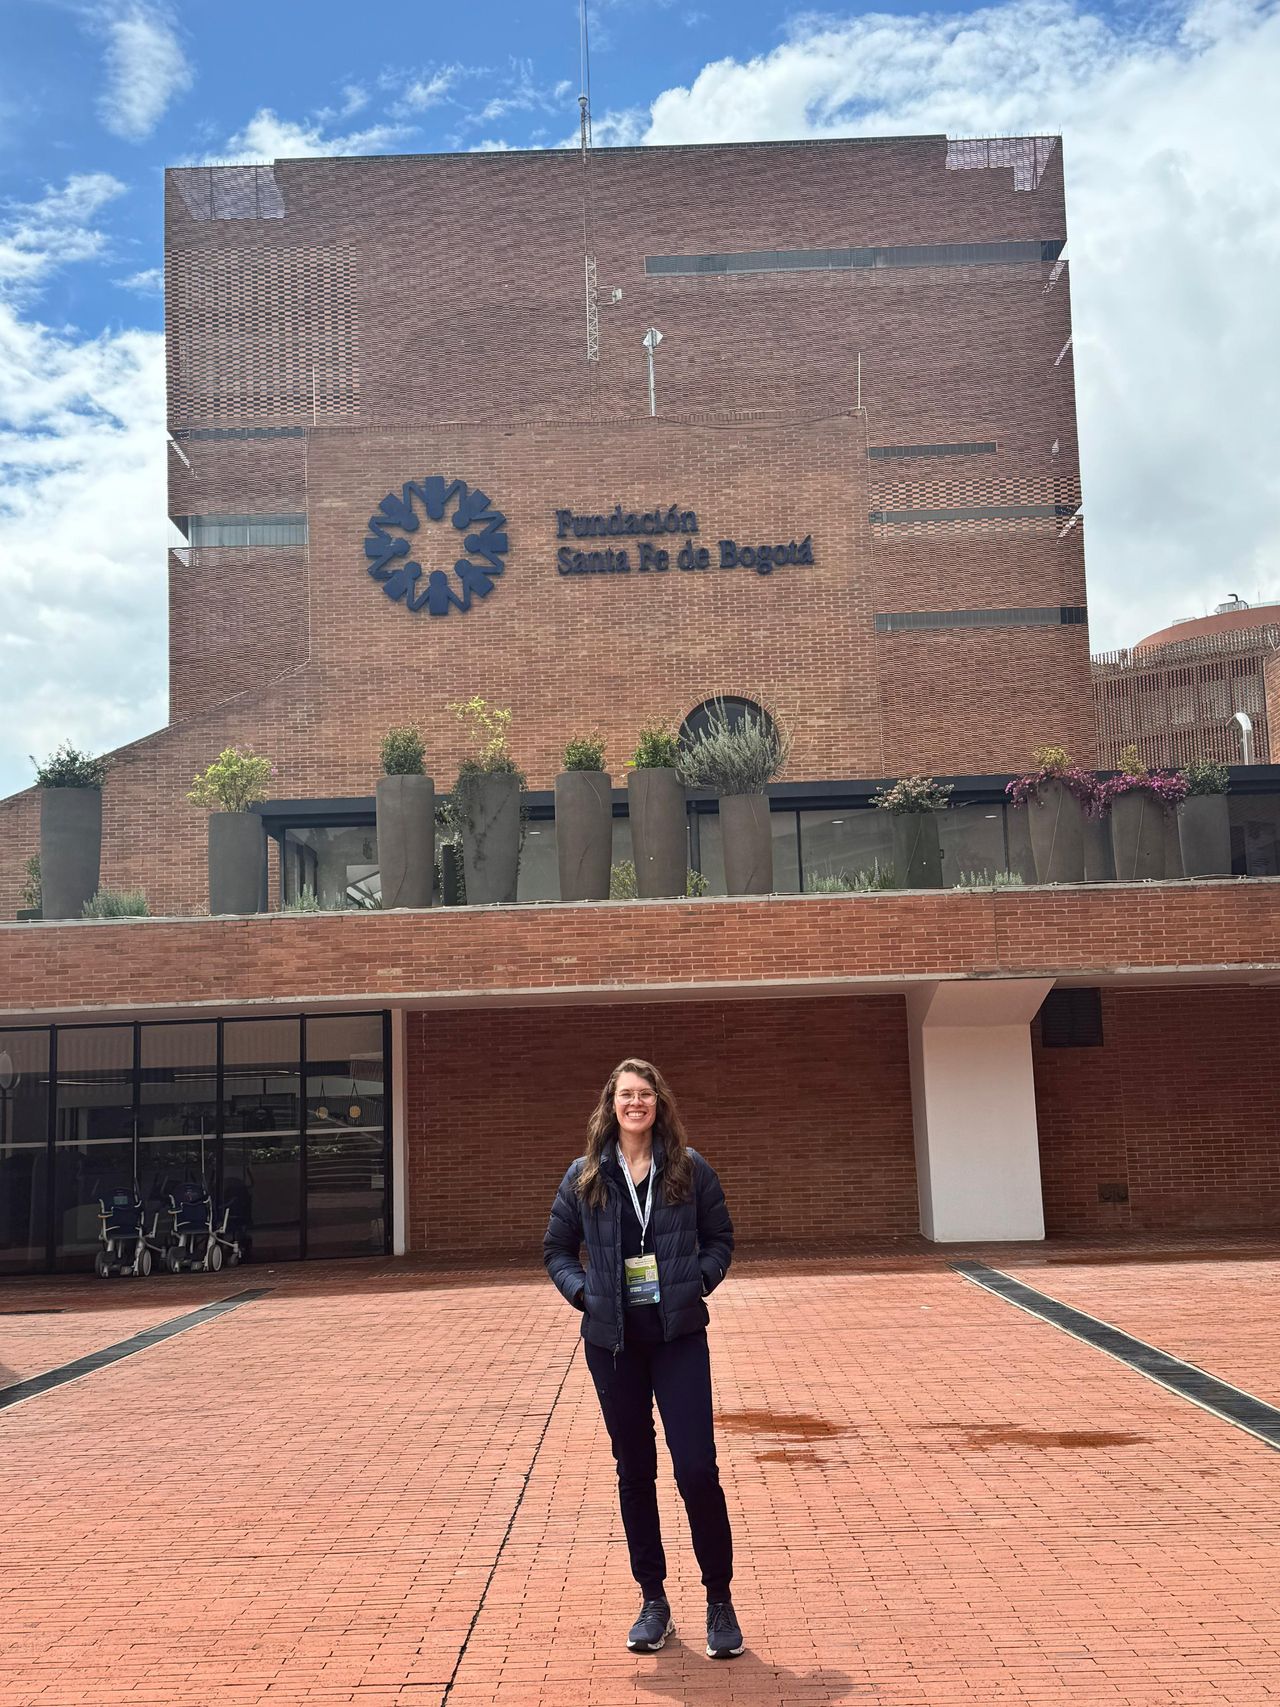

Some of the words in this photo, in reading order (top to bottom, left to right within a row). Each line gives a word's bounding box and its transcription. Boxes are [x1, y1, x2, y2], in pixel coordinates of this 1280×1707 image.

[556, 504, 698, 538] Fundación
[557, 546, 631, 575] Santa
[638, 542, 670, 571] Fe
[677, 539, 710, 571] de
[718, 535, 814, 574] Bogotá
